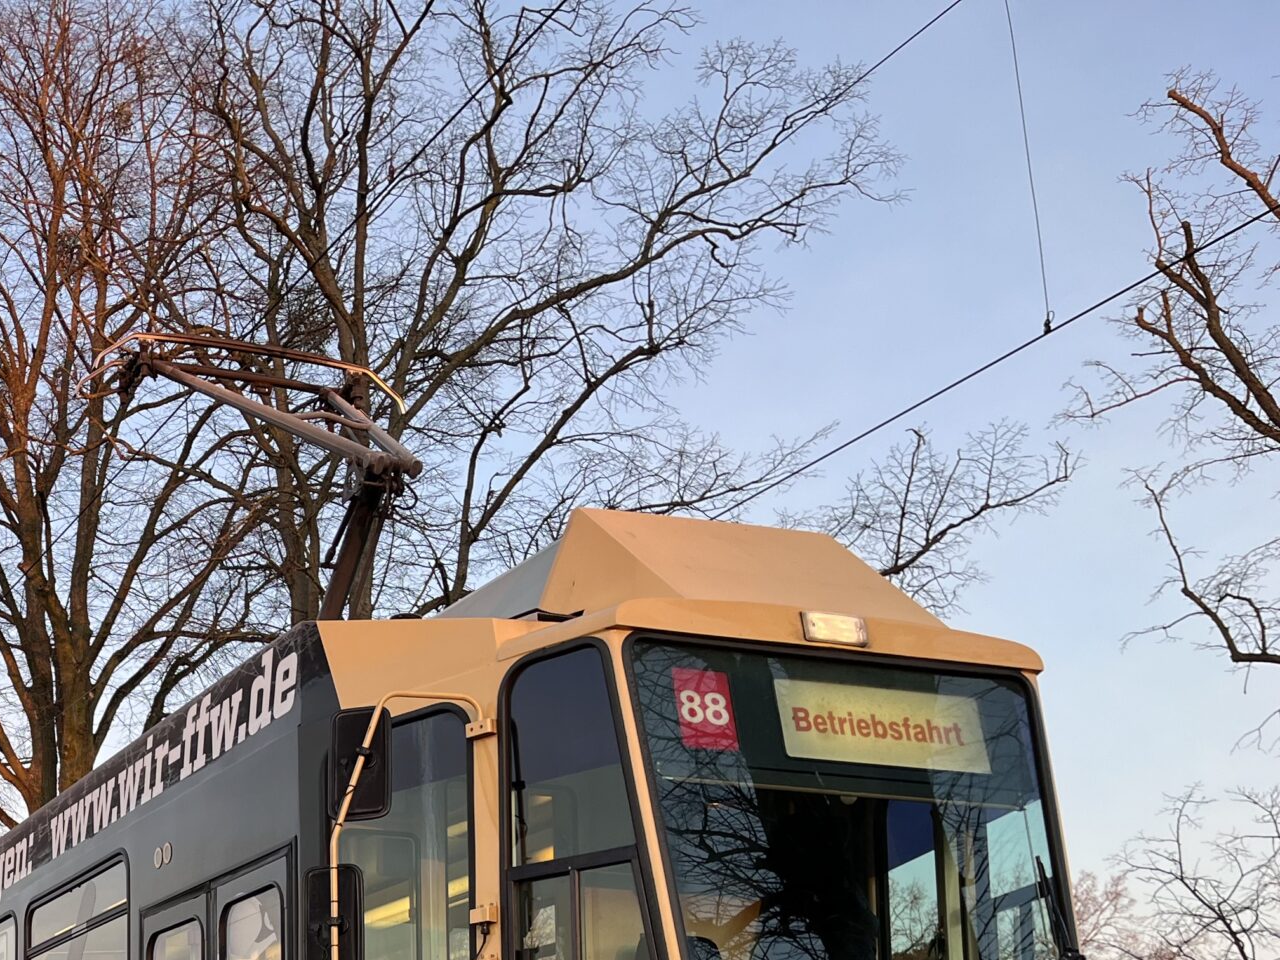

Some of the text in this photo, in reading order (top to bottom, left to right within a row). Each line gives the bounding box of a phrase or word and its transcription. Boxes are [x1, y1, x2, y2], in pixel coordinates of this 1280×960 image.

[679, 689, 729, 725] 88
[791, 706, 964, 746] Betriebsfahrt
[51, 648, 298, 859] www.wir-ffw.de
